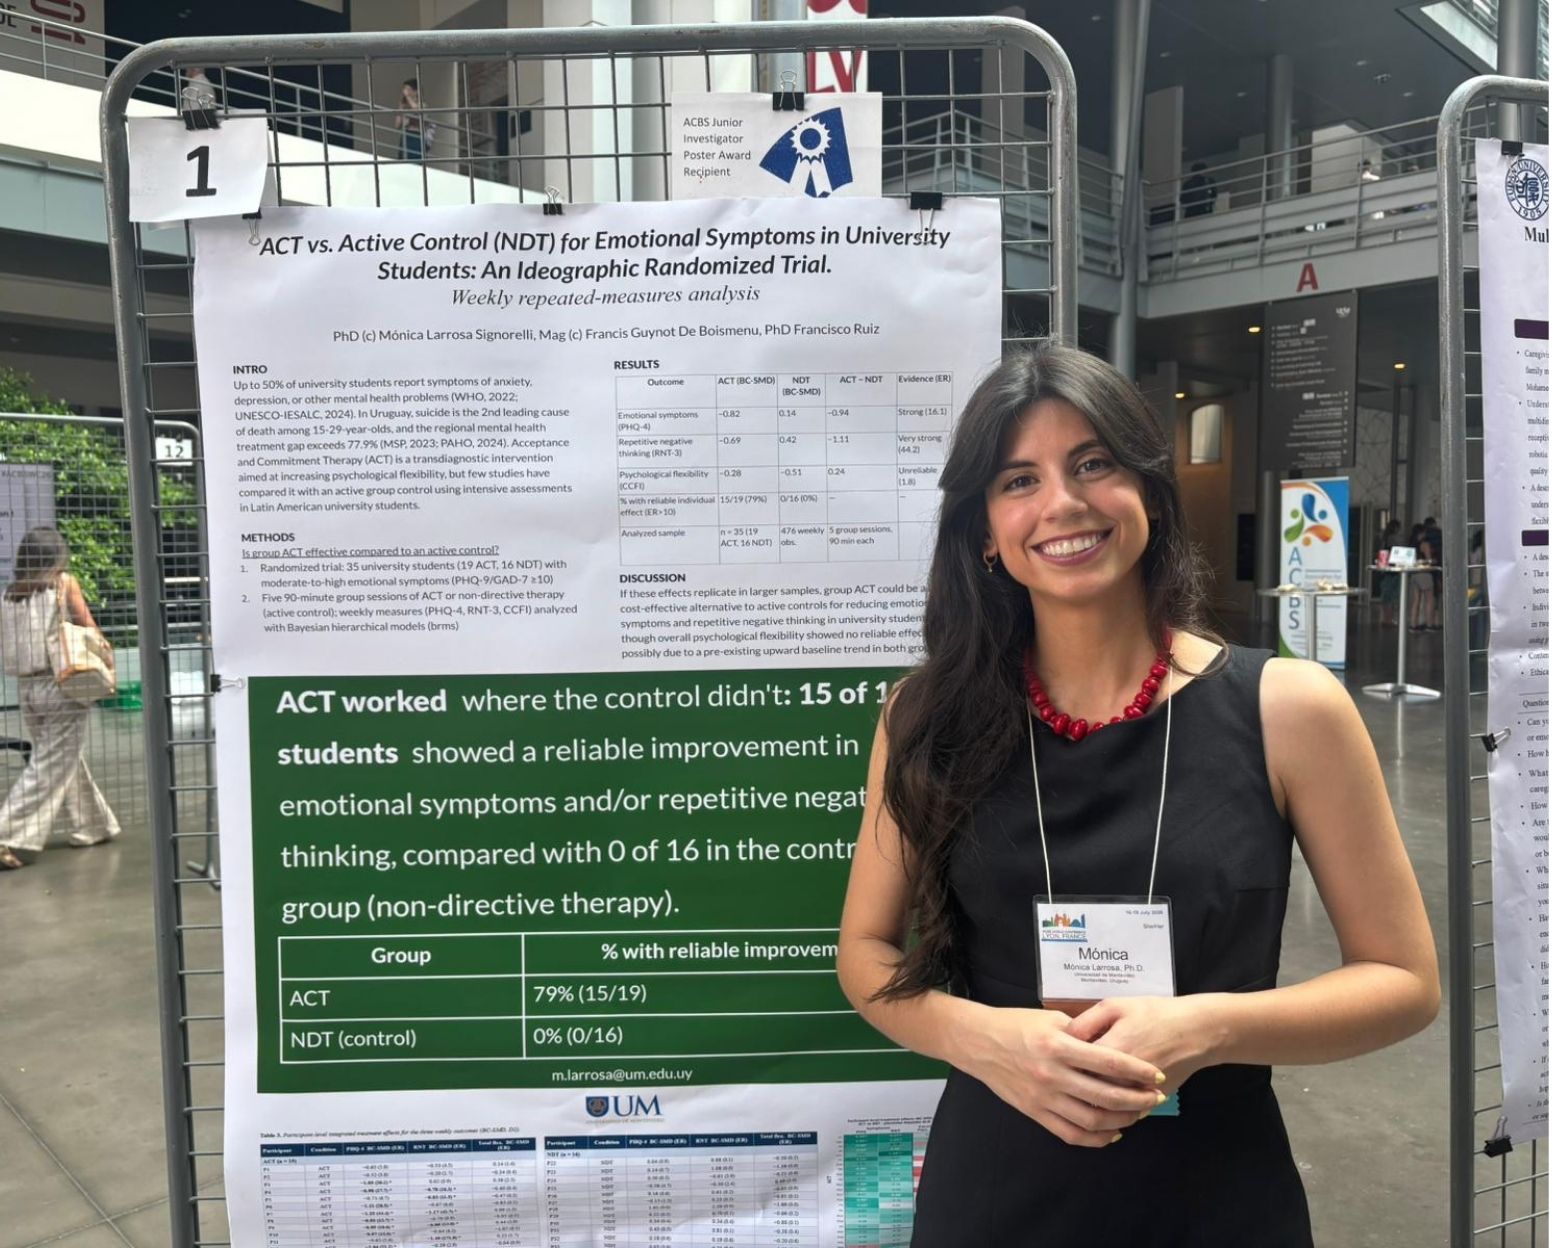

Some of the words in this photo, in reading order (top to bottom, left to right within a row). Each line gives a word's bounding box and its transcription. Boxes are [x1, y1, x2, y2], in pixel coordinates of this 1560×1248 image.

[683, 116, 710, 128] ACBS
[712, 117, 743, 128] Junior
[683, 132, 743, 146] Investigator
[683, 149, 716, 161] Poster
[718, 149, 752, 161] Award
[186, 146, 216, 197] 1
[683, 166, 730, 180] Recipient
[1518, 206, 1542, 218] 1905
[260, 233, 304, 256] ACT
[308, 240, 333, 253] vs.
[338, 234, 404, 253] Active
[410, 231, 488, 252] Control
[494, 230, 555, 254] (NDT)
[560, 231, 590, 255] for
[595, 228, 700, 249] Emotional
[706, 227, 814, 253] Symptoms
[821, 226, 839, 244] in
[846, 225, 950, 250] University
[378, 261, 476, 281] Students:
[481, 260, 510, 280] An
[517, 258, 639, 284] Ideographic
[645, 255, 775, 277] Randomized
[781, 254, 832, 273] Trial.
[1296, 263, 1319, 293] A
[453, 289, 513, 308] Weekly
[519, 287, 682, 307] repeated-measures
[688, 285, 760, 304] analysis
[233, 364, 268, 375] INTRO
[614, 359, 660, 370] RESULTS
[234, 380, 248, 391] Up
[250, 380, 260, 390] to
[263, 379, 284, 390] 50%
[285, 378, 295, 388] of
[298, 378, 347, 391] university
[350, 377, 391, 388] students
[394, 377, 424, 389] report
[427, 377, 479, 389] symptoms
[481, 376, 491, 386] of
[494, 376, 533, 388] anxiety,
[647, 377, 684, 387] Outcome
[618, 411, 656, 420] Emotional
[659, 411, 698, 422] symptoms
[898, 408, 923, 418] Strong
[924, 407, 947, 417] (16.1)
[165, 445, 185, 458] 12
[720, 495, 744, 504] 15/19
[745, 494, 767, 505] (79%)
[241, 532, 295, 543] METHODS
[619, 573, 686, 584] DISCUSSION
[276, 689, 337, 714] ACT
[341, 688, 447, 713] worked
[462, 689, 546, 712] where
[554, 687, 597, 711] the
[604, 684, 700, 709] control
[707, 683, 791, 708] didn't:
[799, 683, 832, 705] 15
[839, 681, 868, 705] of
[875, 681, 888, 704] 1
[277, 741, 398, 765] students
[412, 740, 514, 764] showed
[523, 745, 536, 763] a
[543, 737, 644, 763] reliable
[651, 735, 828, 763] improvement
[836, 733, 859, 756] in
[279, 791, 413, 817] emotional
[420, 793, 556, 822] symptoms
[564, 787, 652, 813] and/or
[659, 785, 788, 814] repetitive
[795, 787, 867, 813] negat
[281, 843, 397, 872] thinking,
[403, 841, 535, 870] compared
[542, 840, 601, 865] with
[608, 840, 625, 863] 0
[632, 838, 659, 863] of
[667, 839, 699, 862] 16
[706, 837, 729, 861] in
[736, 837, 780, 861] the
[787, 838, 856, 861] contr
[282, 899, 361, 922] group
[368, 891, 555, 920] (non-directive
[562, 889, 680, 918] therapy).
[371, 947, 431, 965] Group
[601, 943, 618, 961] %
[623, 942, 665, 960] with
[669, 942, 739, 960] reliable
[744, 941, 838, 960] improvem
[1078, 947, 1129, 961] Mónica
[1064, 963, 1090, 971] Mónica
[1092, 963, 1121, 971] Larrosa,
[1124, 964, 1145, 972] Ph.D.
[290, 989, 331, 1007] ACT
[533, 985, 574, 1004] 79%
[578, 984, 647, 1004] (15/19)
[291, 1031, 334, 1049] NDT
[338, 1029, 417, 1050] (control)
[533, 1027, 563, 1045] 0%
[567, 1026, 623, 1047] (0/16)
[552, 1067, 693, 1083] m.larrosa@um.edu.uy
[611, 1095, 662, 1117] UM
